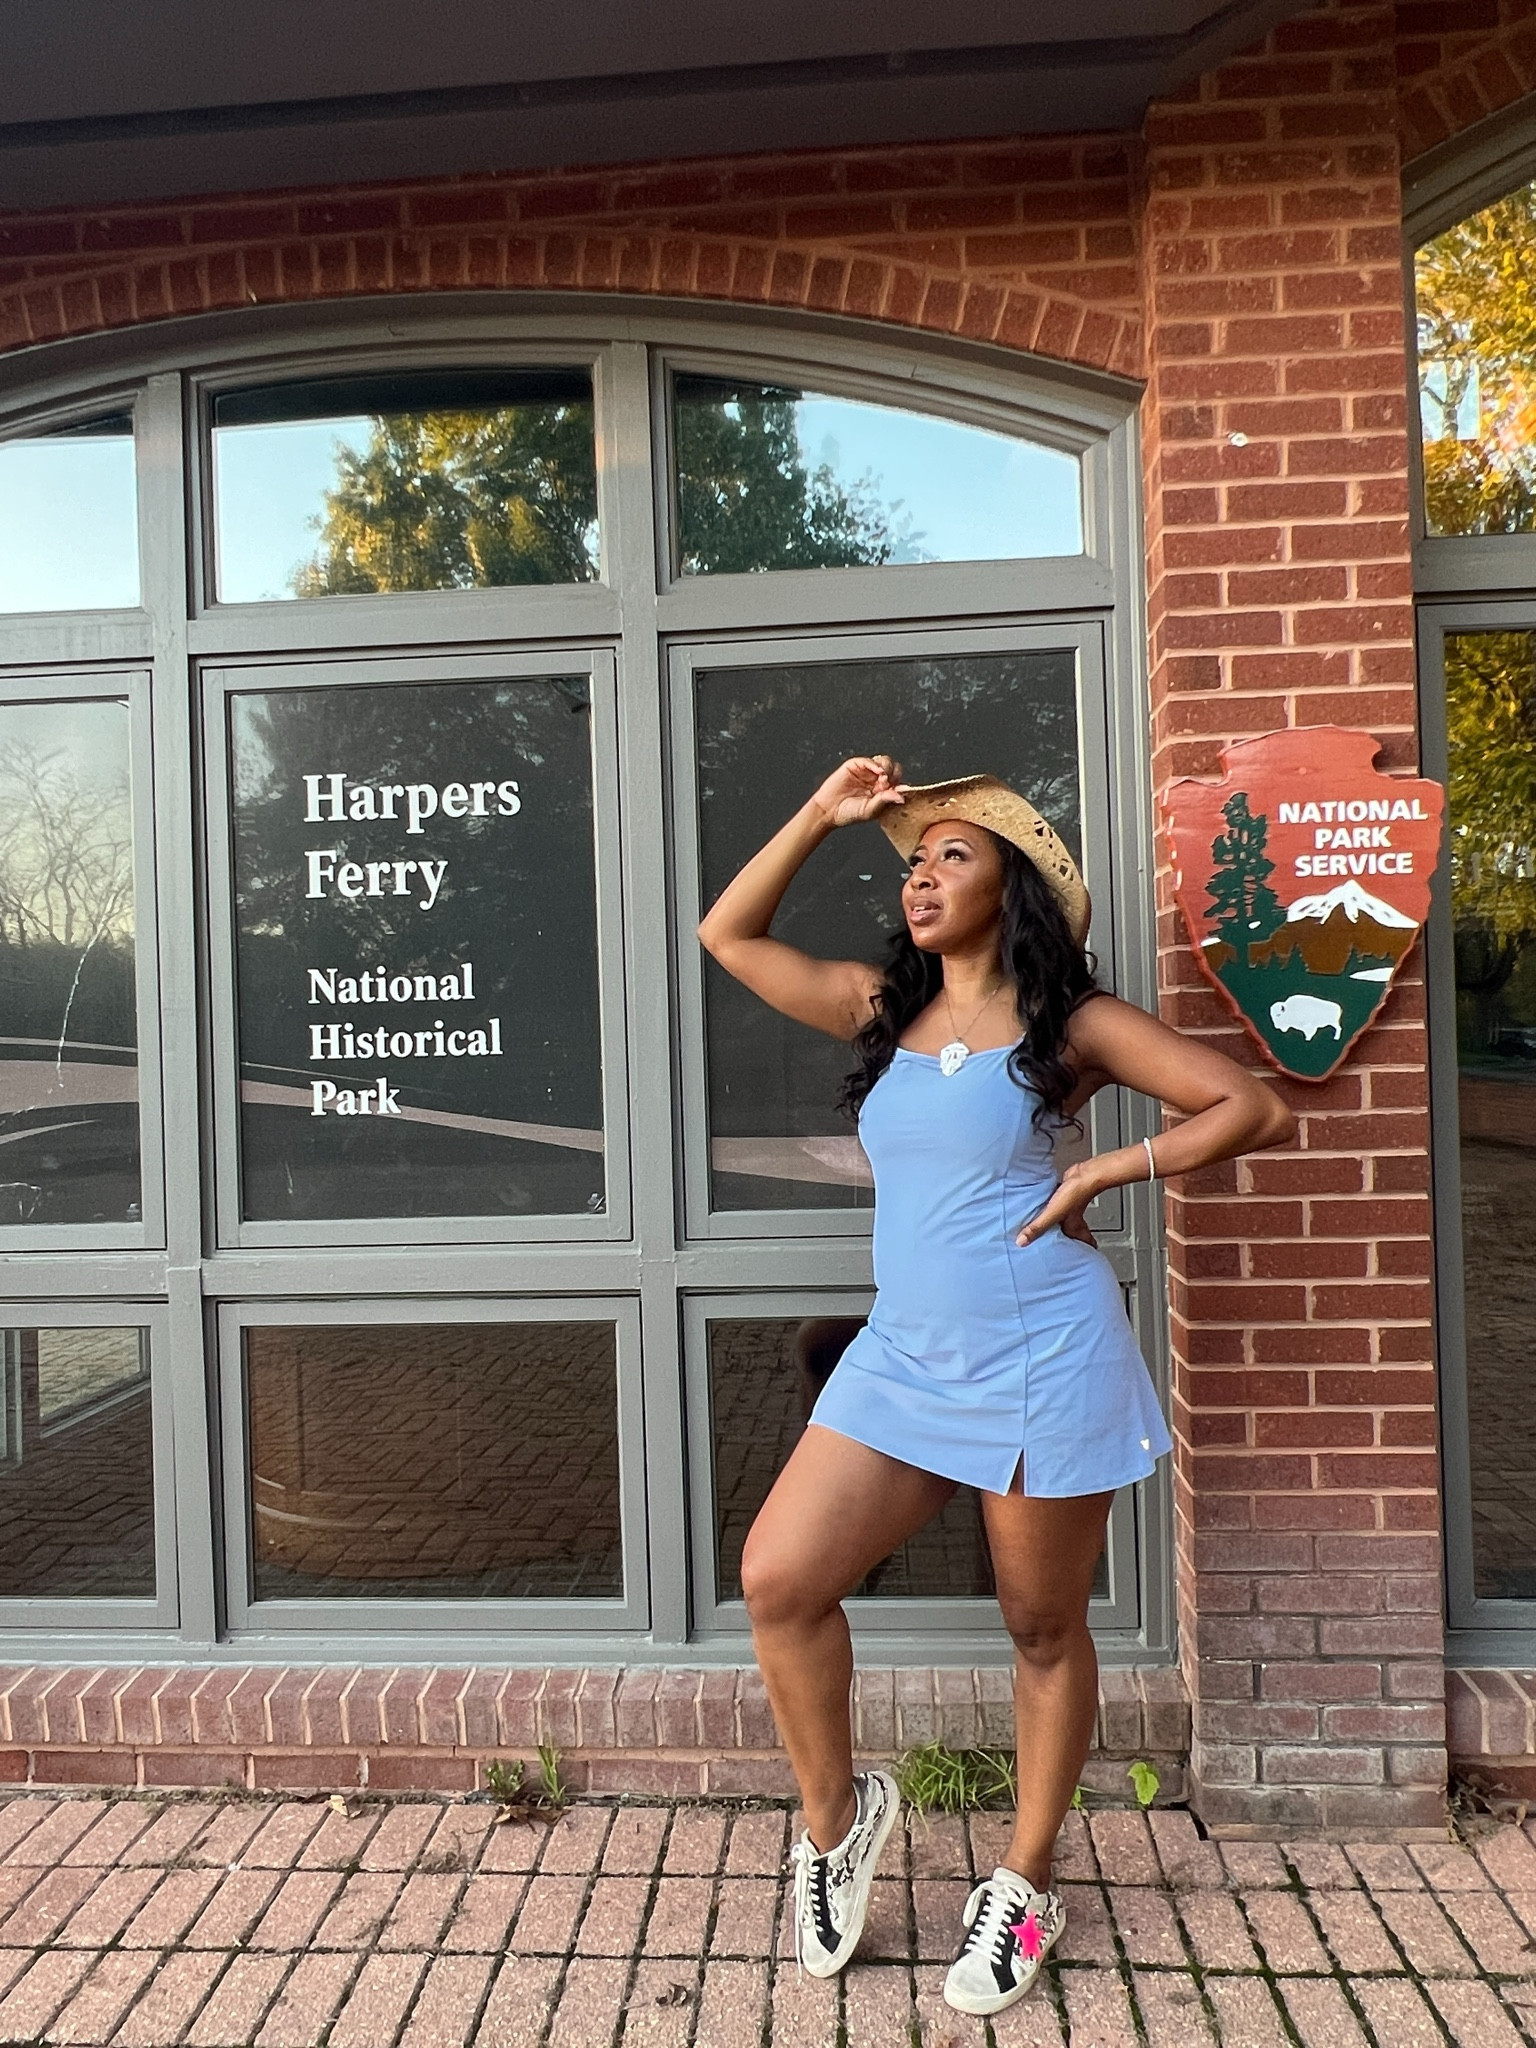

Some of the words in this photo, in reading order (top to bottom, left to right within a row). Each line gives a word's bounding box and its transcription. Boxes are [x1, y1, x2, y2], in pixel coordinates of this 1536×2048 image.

[302, 773, 521, 834] Harpers
[1279, 799, 1429, 824] NATIONAL
[1315, 826, 1392, 849] PARK
[304, 849, 448, 910] Ferry
[1295, 853, 1413, 877] SERVICE
[308, 963, 475, 1004] National
[309, 1018, 503, 1060] Historical
[310, 1077, 401, 1116] Park
